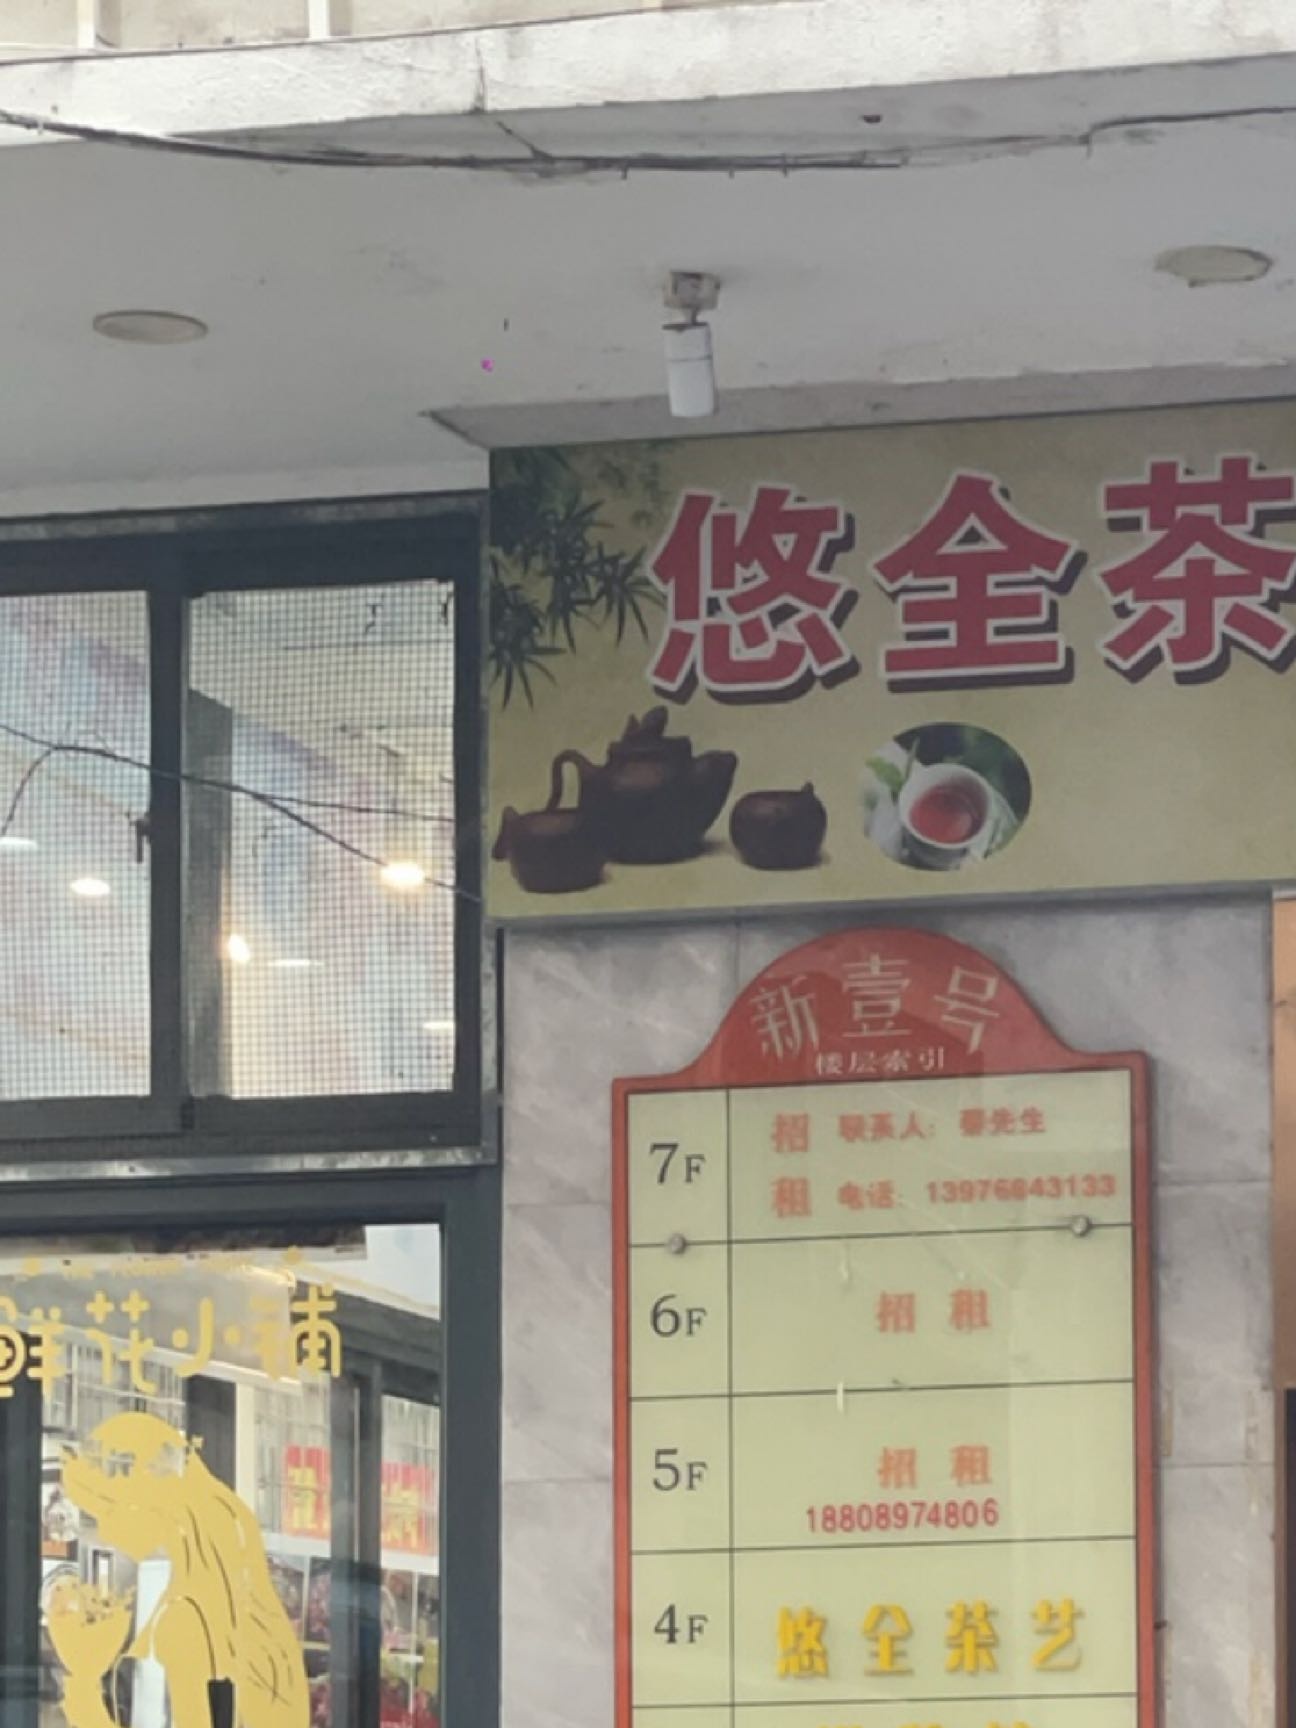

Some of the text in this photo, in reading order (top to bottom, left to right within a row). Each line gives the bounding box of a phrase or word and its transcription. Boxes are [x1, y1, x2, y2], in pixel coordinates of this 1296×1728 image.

[750, 953, 1002, 1061] 新壹号
[648, 1142, 706, 1186] 7F
[650, 1294, 707, 1339] 6F
[652, 1447, 708, 1492] 5F
[806, 1498, 1000, 1535] 18808974806
[653, 1604, 708, 1645] 4F
[774, 1596, 1084, 1679] 悠全茶艺
